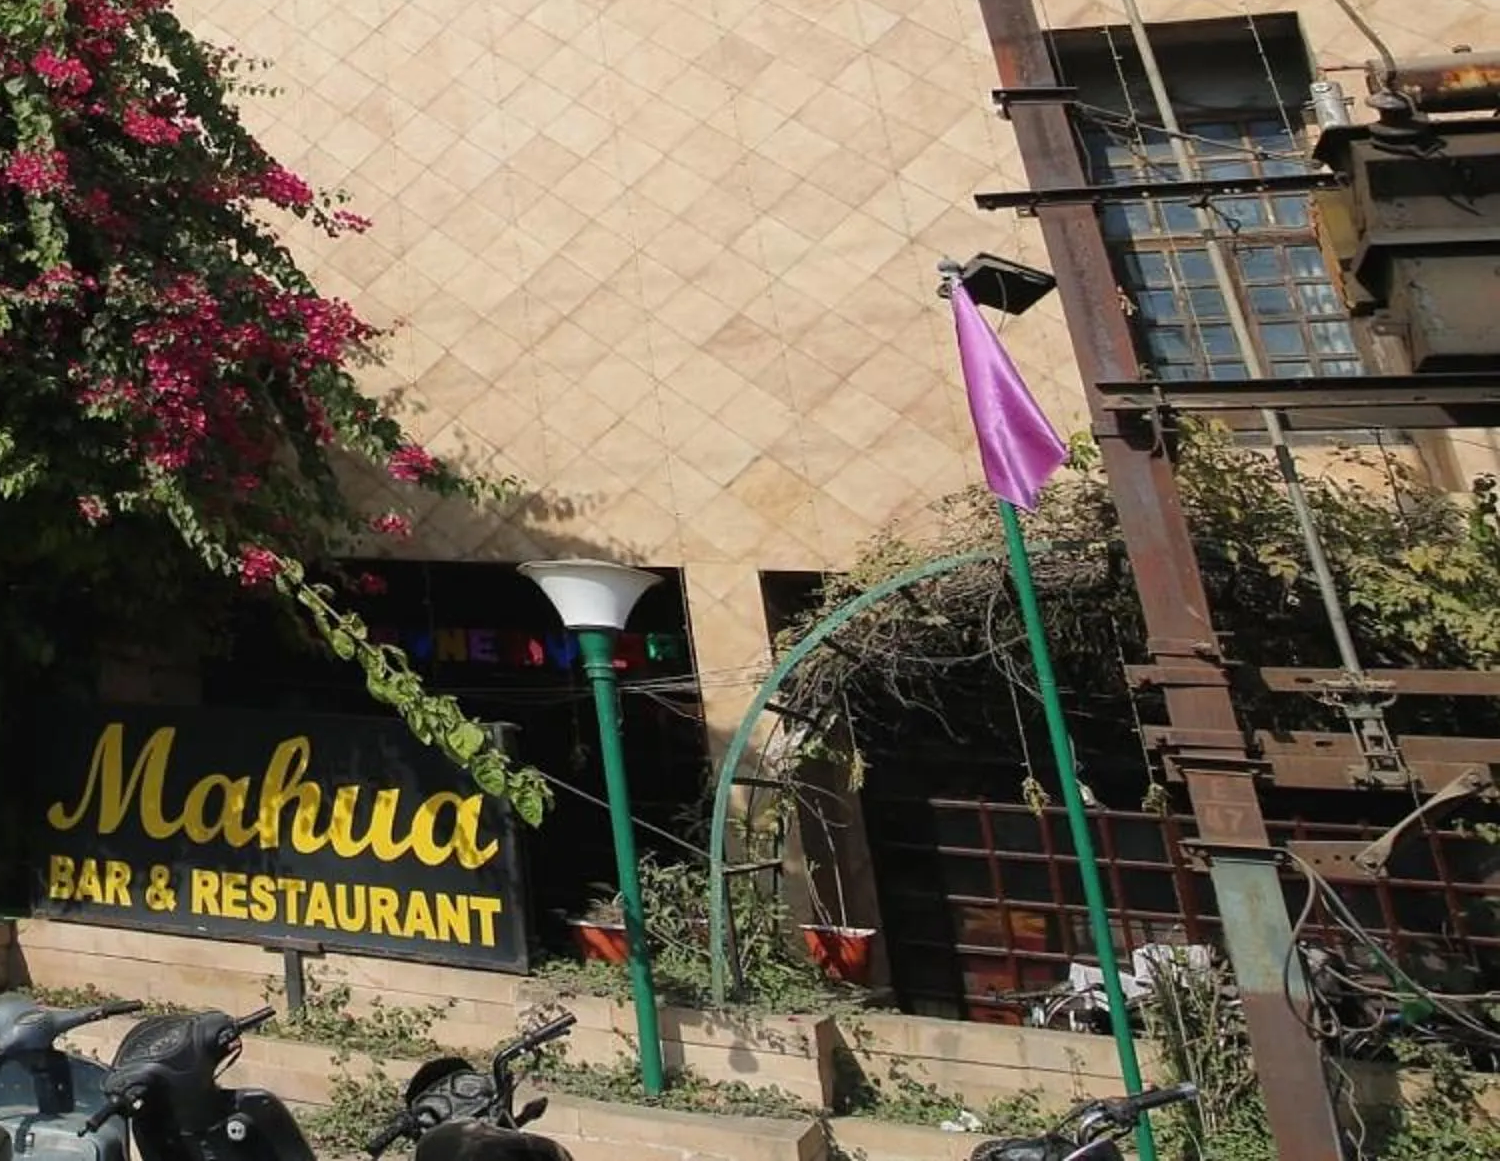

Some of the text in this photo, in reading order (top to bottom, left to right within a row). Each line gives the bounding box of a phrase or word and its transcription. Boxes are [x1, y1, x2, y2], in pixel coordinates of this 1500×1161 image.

[47, 722, 499, 870] Mahua
[49, 854, 502, 947] BAR & RESTAURANT
